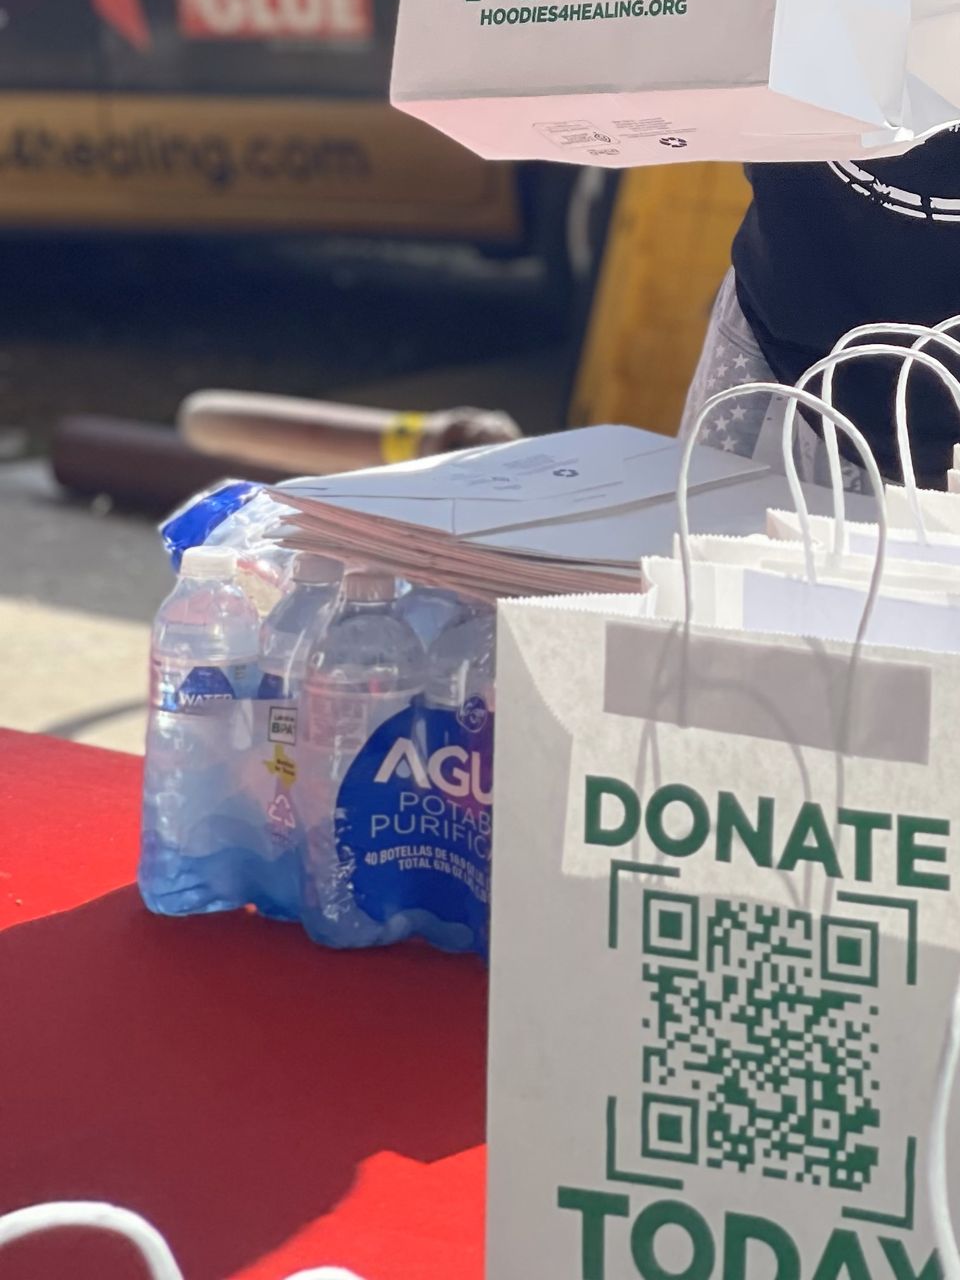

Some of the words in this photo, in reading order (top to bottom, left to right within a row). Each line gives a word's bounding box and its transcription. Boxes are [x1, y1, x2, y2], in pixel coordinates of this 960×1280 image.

[373, 736, 493, 805] AGU
[371, 813, 492, 861] PURIFIC
[380, 845, 433, 864] BOTELLAS
[584, 775, 950, 891] DONATE
[399, 857, 432, 871] TOTAL
